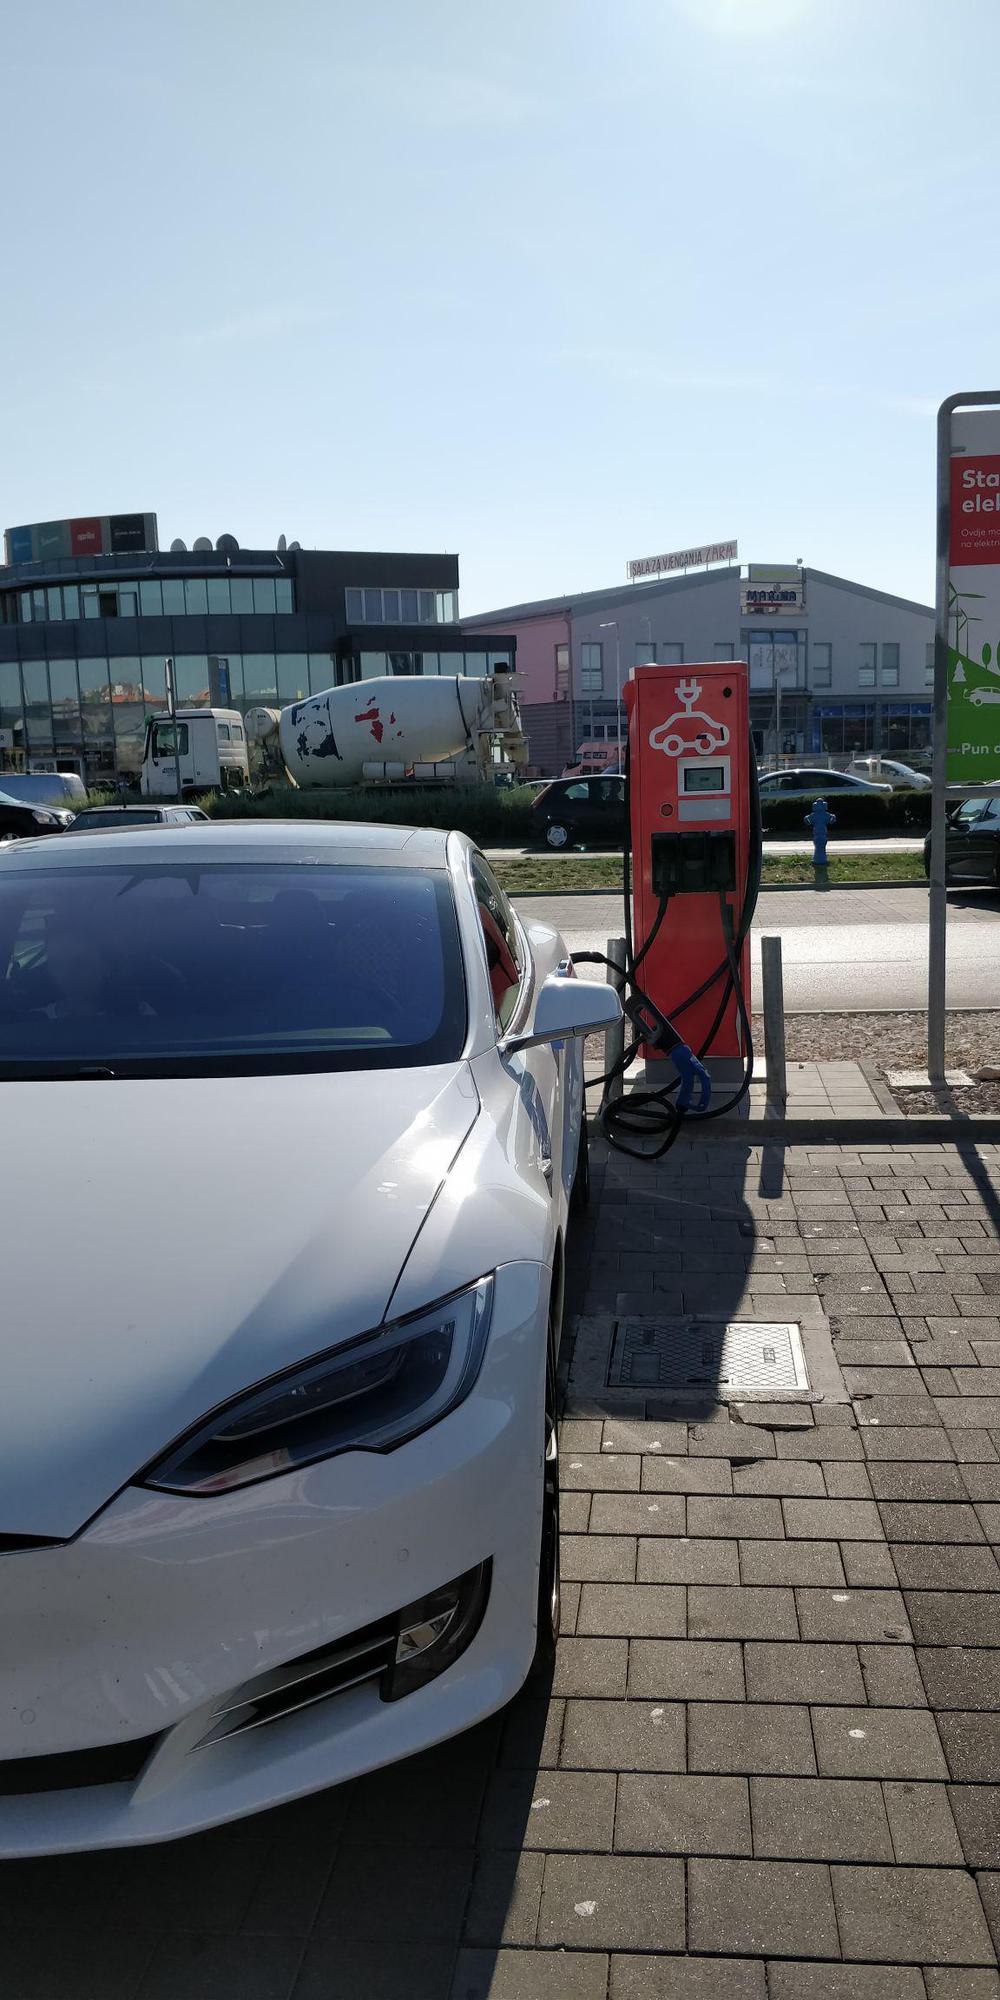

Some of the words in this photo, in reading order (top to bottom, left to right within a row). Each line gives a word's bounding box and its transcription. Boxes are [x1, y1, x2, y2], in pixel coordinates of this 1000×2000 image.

[962, 469, 1000, 489] Sta
[961, 528, 986, 538] Ovdje
[632, 560, 650, 577] SALA
[652, 558, 661, 573] ZA
[961, 742, 990, 755] Pun
